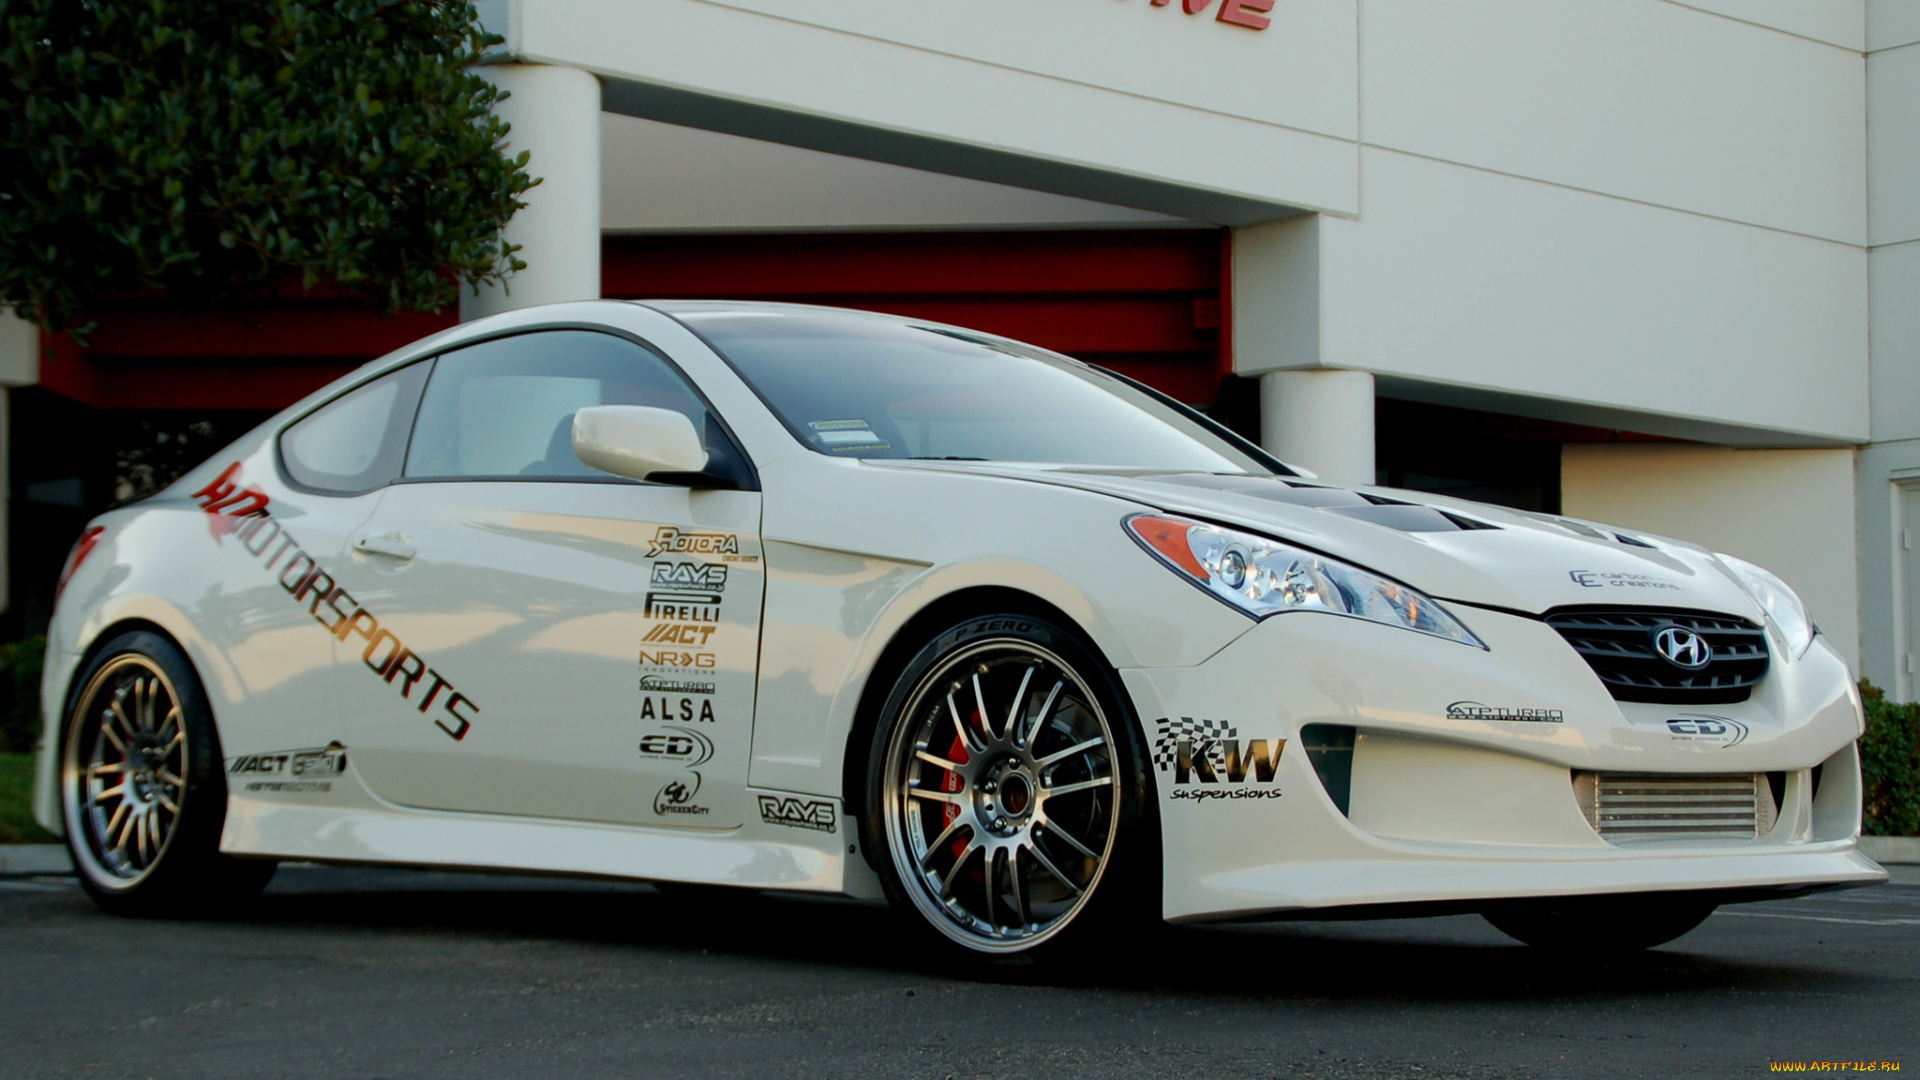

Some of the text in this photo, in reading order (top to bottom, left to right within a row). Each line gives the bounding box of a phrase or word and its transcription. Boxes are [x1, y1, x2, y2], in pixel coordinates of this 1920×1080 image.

[650, 561, 728, 584] RAYS
[644, 592, 722, 622] PIRELLI
[973, 620, 1034, 633] ZERO
[640, 697, 716, 722] ALSA
[1449, 705, 1563, 718] ATPTURBO
[1175, 739, 1288, 784] KW
[1170, 787, 1282, 804] suspensions
[758, 795, 836, 825] RAYS
